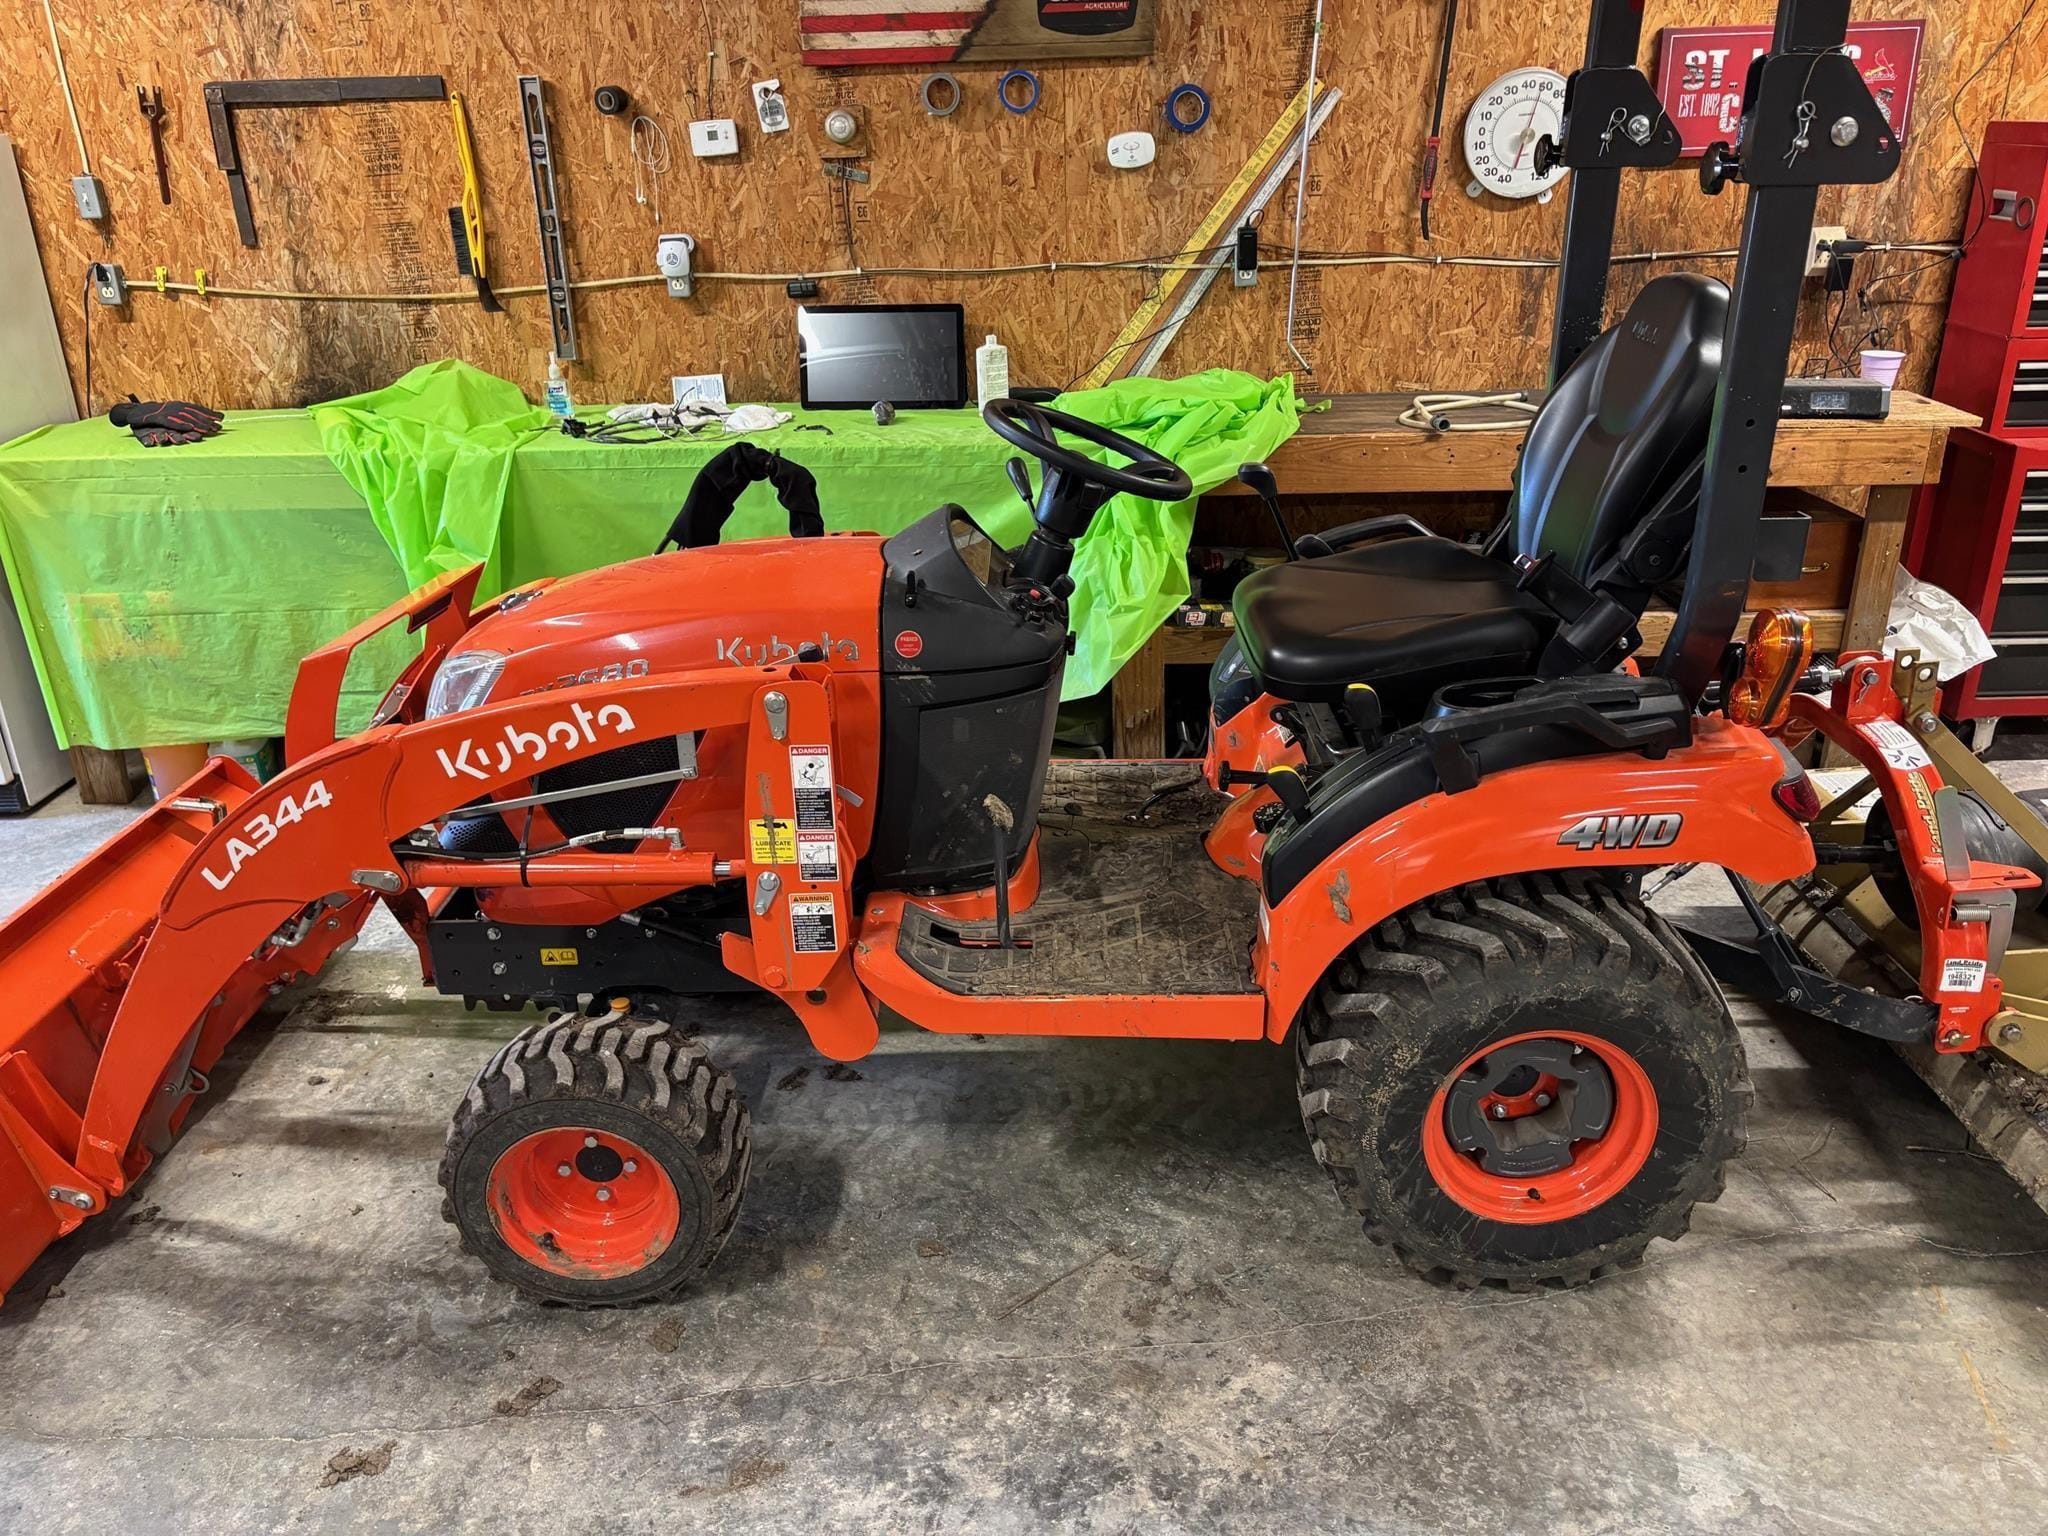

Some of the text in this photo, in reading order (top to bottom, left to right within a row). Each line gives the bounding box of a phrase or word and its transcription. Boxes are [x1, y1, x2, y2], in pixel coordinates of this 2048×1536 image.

[1084, 2, 1129, 10] AGRICULTURE
[1521, 79, 1537, 89] 40
[1539, 81, 1553, 92] 50
[1503, 85, 1519, 96] 30
[1488, 96, 1503, 106] 20
[1678, 93, 1697, 118] EST.
[1700, 92, 1720, 117] 1892
[1480, 111, 1493, 121] 10
[1478, 127, 1486, 136] 0
[435, 702, 636, 781] Kubota
[200, 779, 334, 891] LA344
[1556, 812, 1684, 851] 4WD
